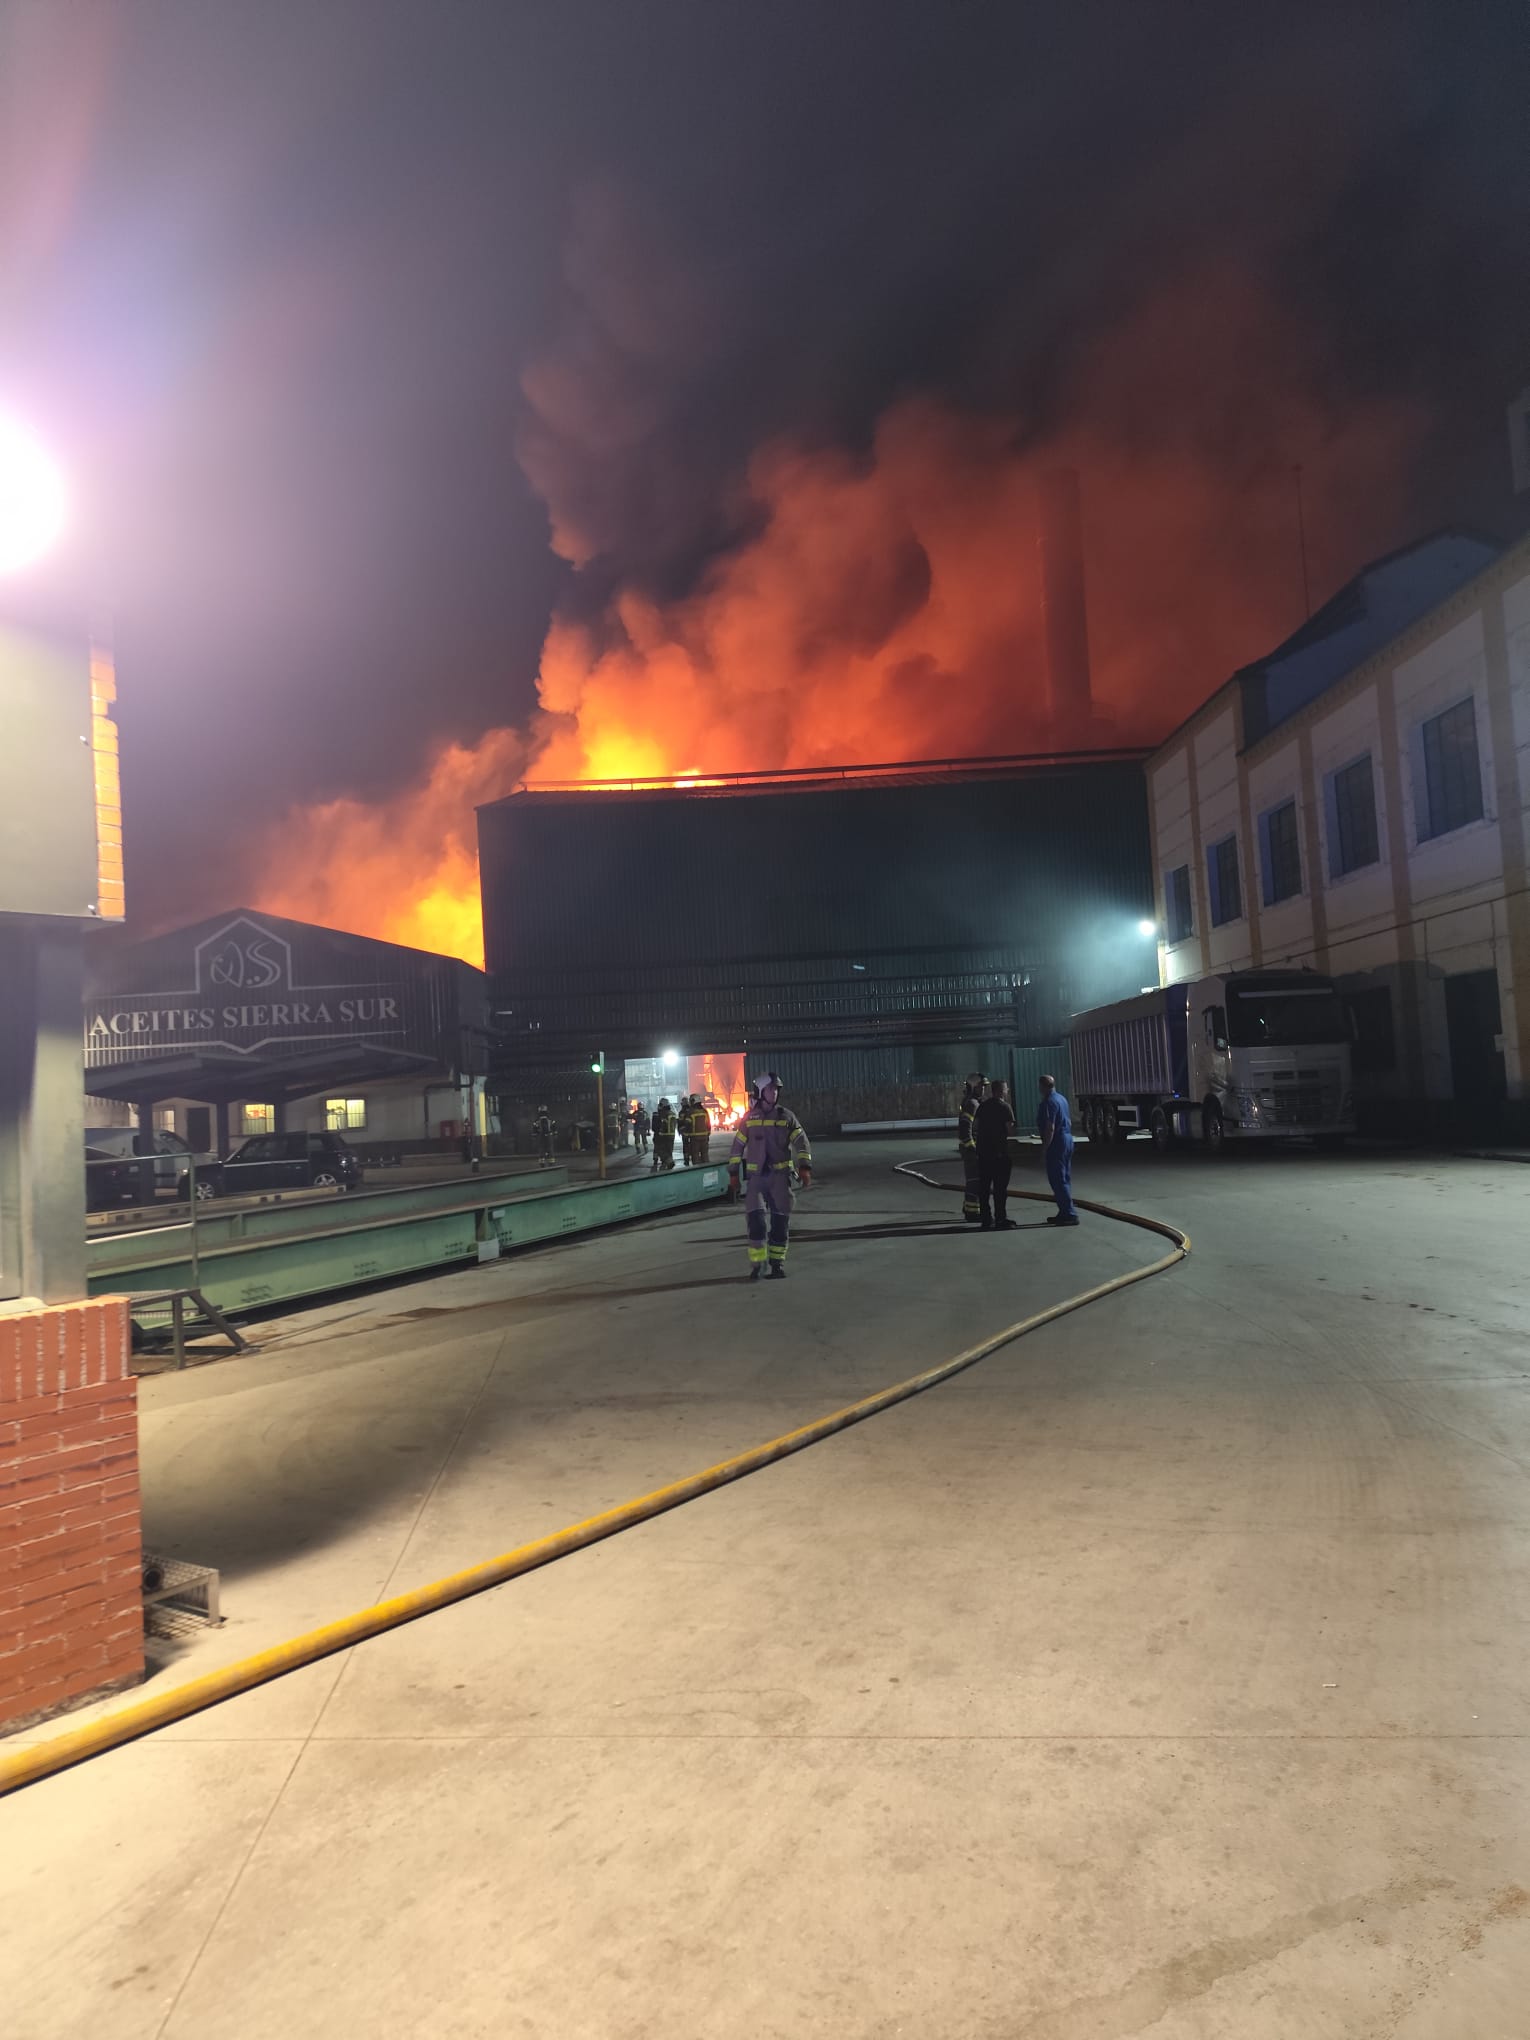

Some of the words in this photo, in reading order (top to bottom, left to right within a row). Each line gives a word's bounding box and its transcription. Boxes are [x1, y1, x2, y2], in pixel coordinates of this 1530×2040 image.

[88, 1007, 215, 1036] ACEITES
[222, 1002, 332, 1029] SIERRA
[339, 998, 399, 1022] SUR
